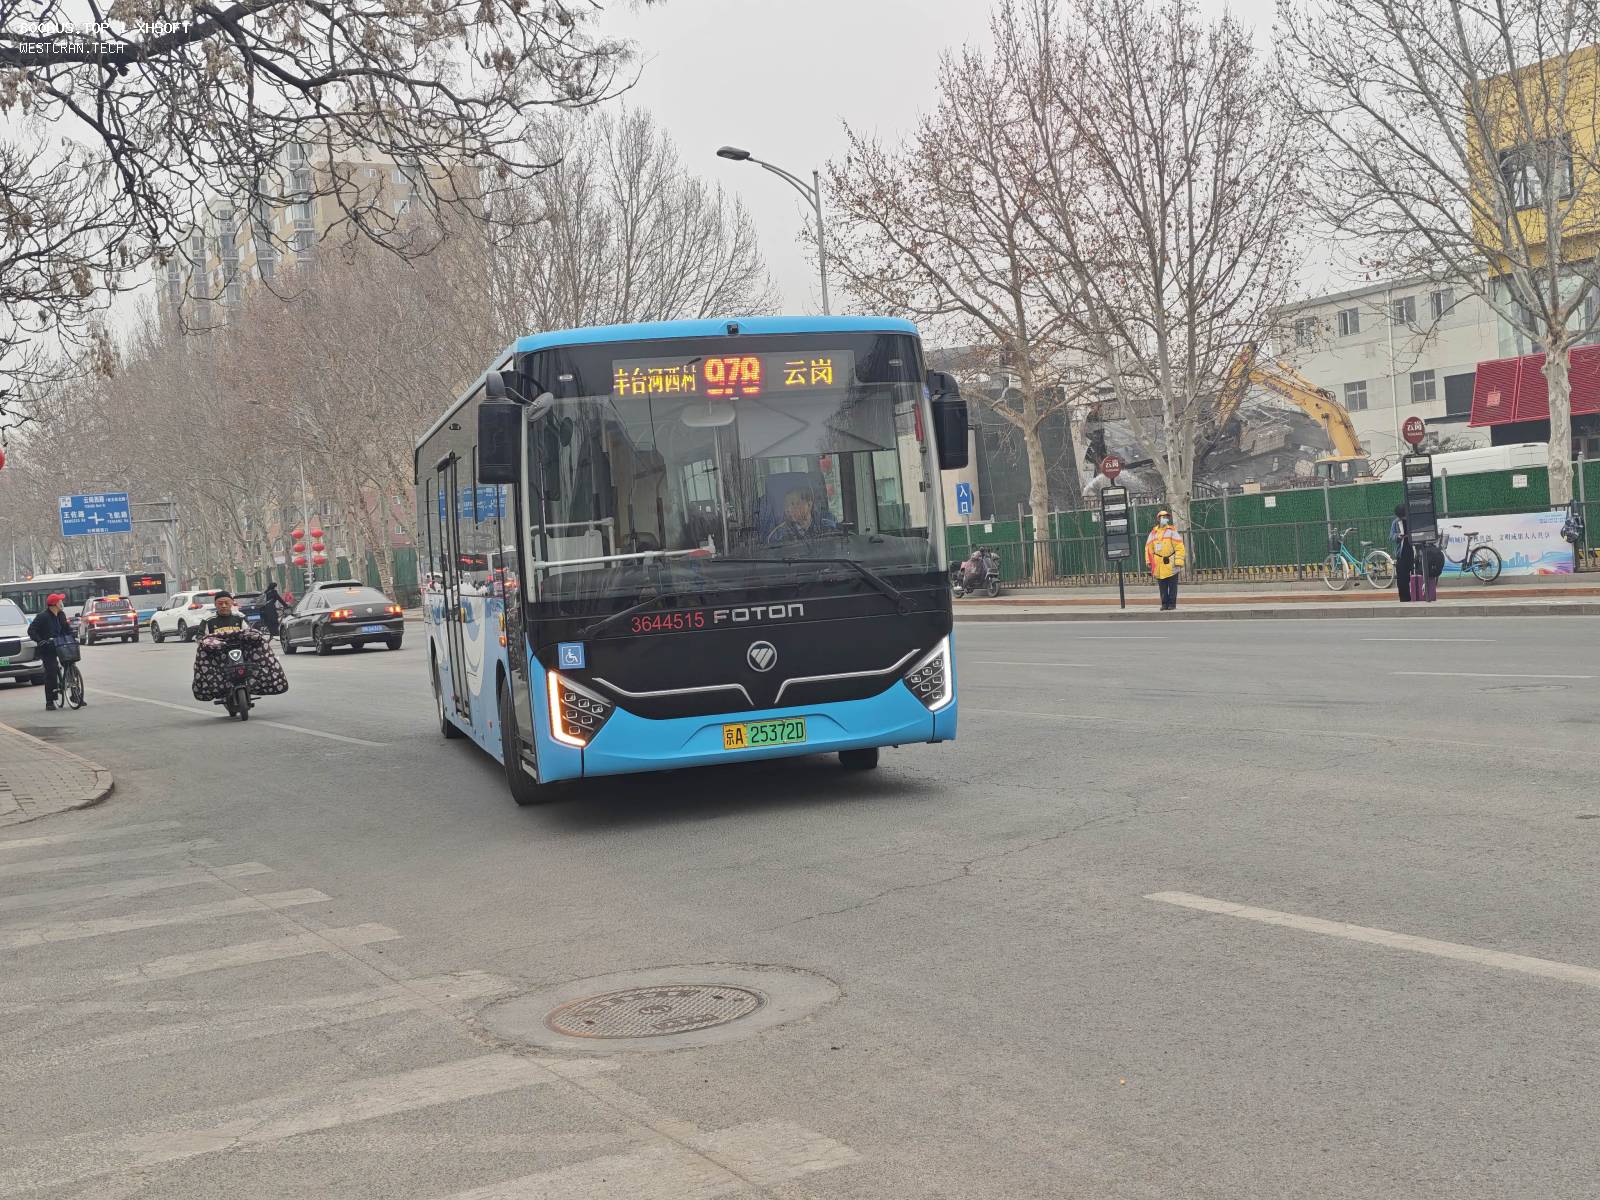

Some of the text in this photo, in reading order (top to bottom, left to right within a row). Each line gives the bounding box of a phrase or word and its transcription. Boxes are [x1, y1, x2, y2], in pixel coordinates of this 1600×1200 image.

[613, 364, 697, 395] 丰台河西村
[783, 358, 832, 385] 云岗
[959, 484, 969, 513] 入口
[631, 603, 804, 633] 3644515 FOTON
